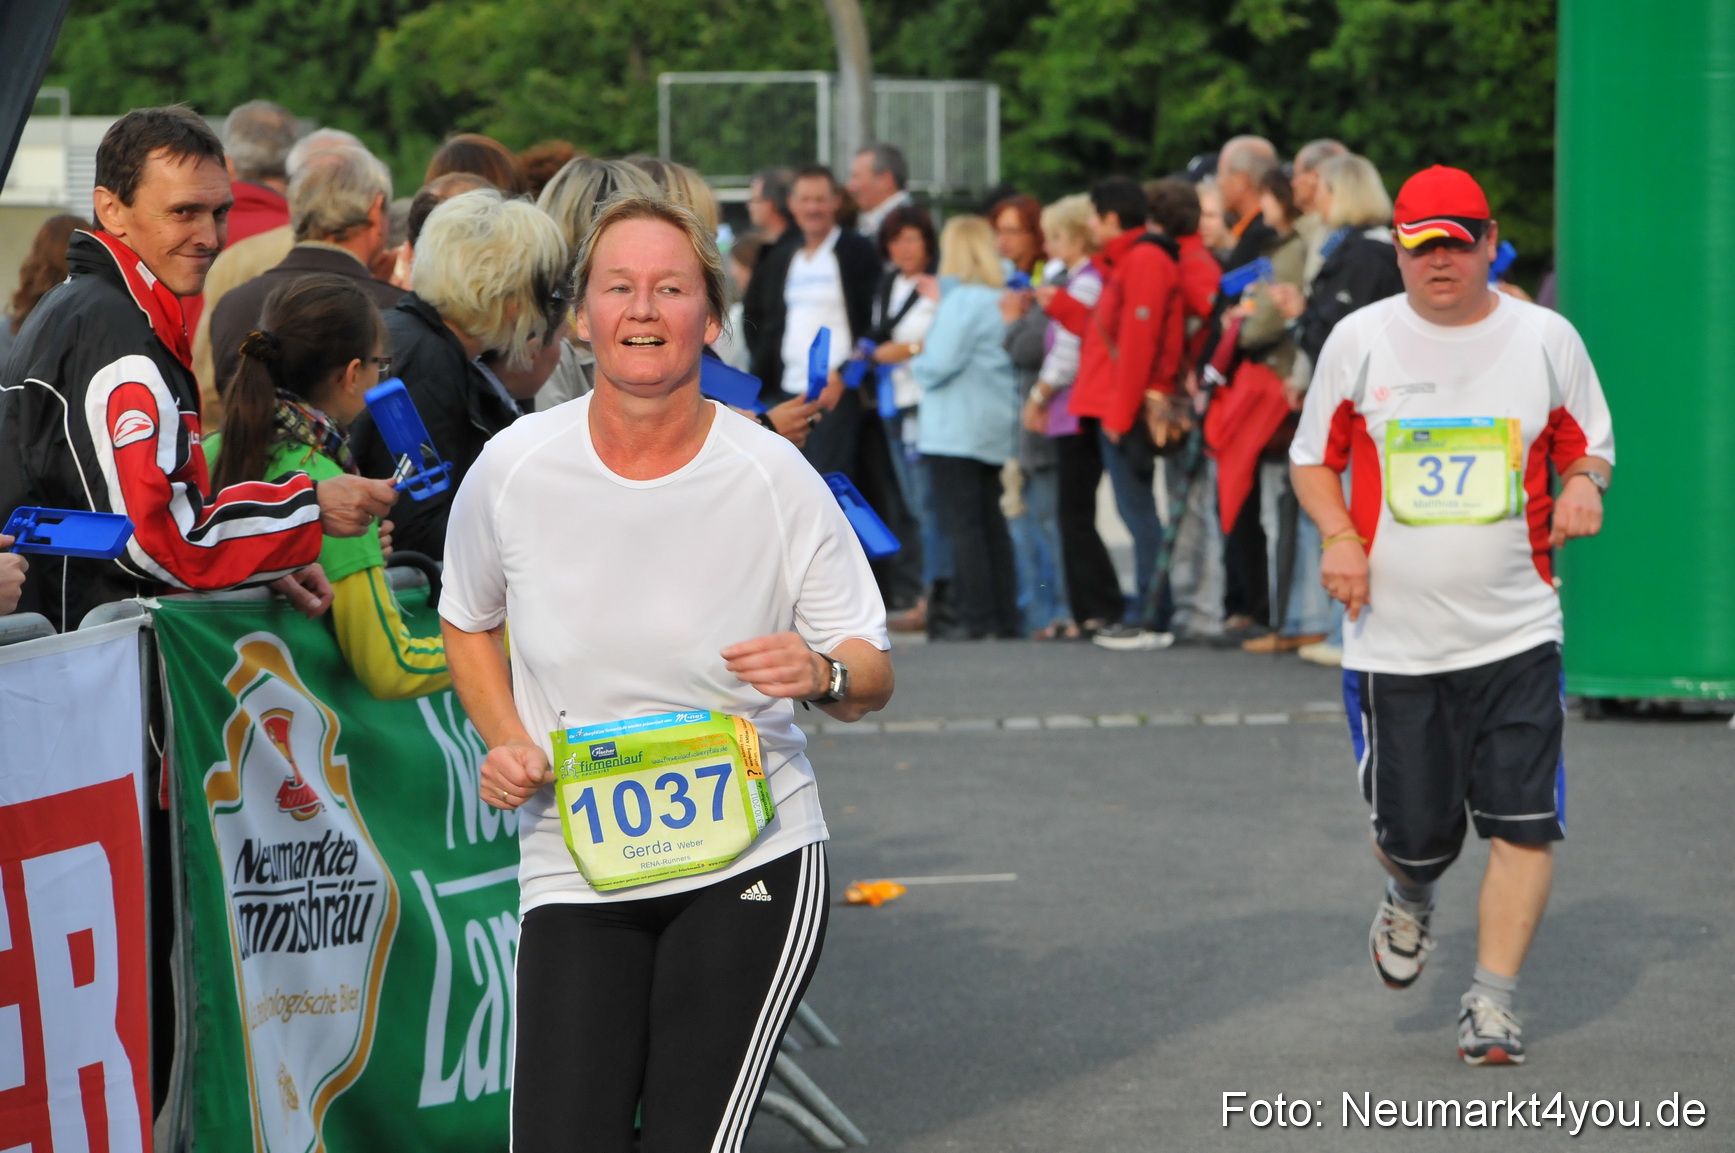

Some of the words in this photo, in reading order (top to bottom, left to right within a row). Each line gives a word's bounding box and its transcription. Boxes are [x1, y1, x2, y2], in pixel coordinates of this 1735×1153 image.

[1417, 455, 1477, 496] 37
[417, 690, 520, 851] Ne
[580, 751, 643, 772] firmenlauf
[571, 762, 733, 845] 1037
[622, 839, 673, 860] Gerda
[676, 838, 704, 850] Weber
[640, 854, 692, 870] RENA-Runners
[740, 892, 772, 902] adidas
